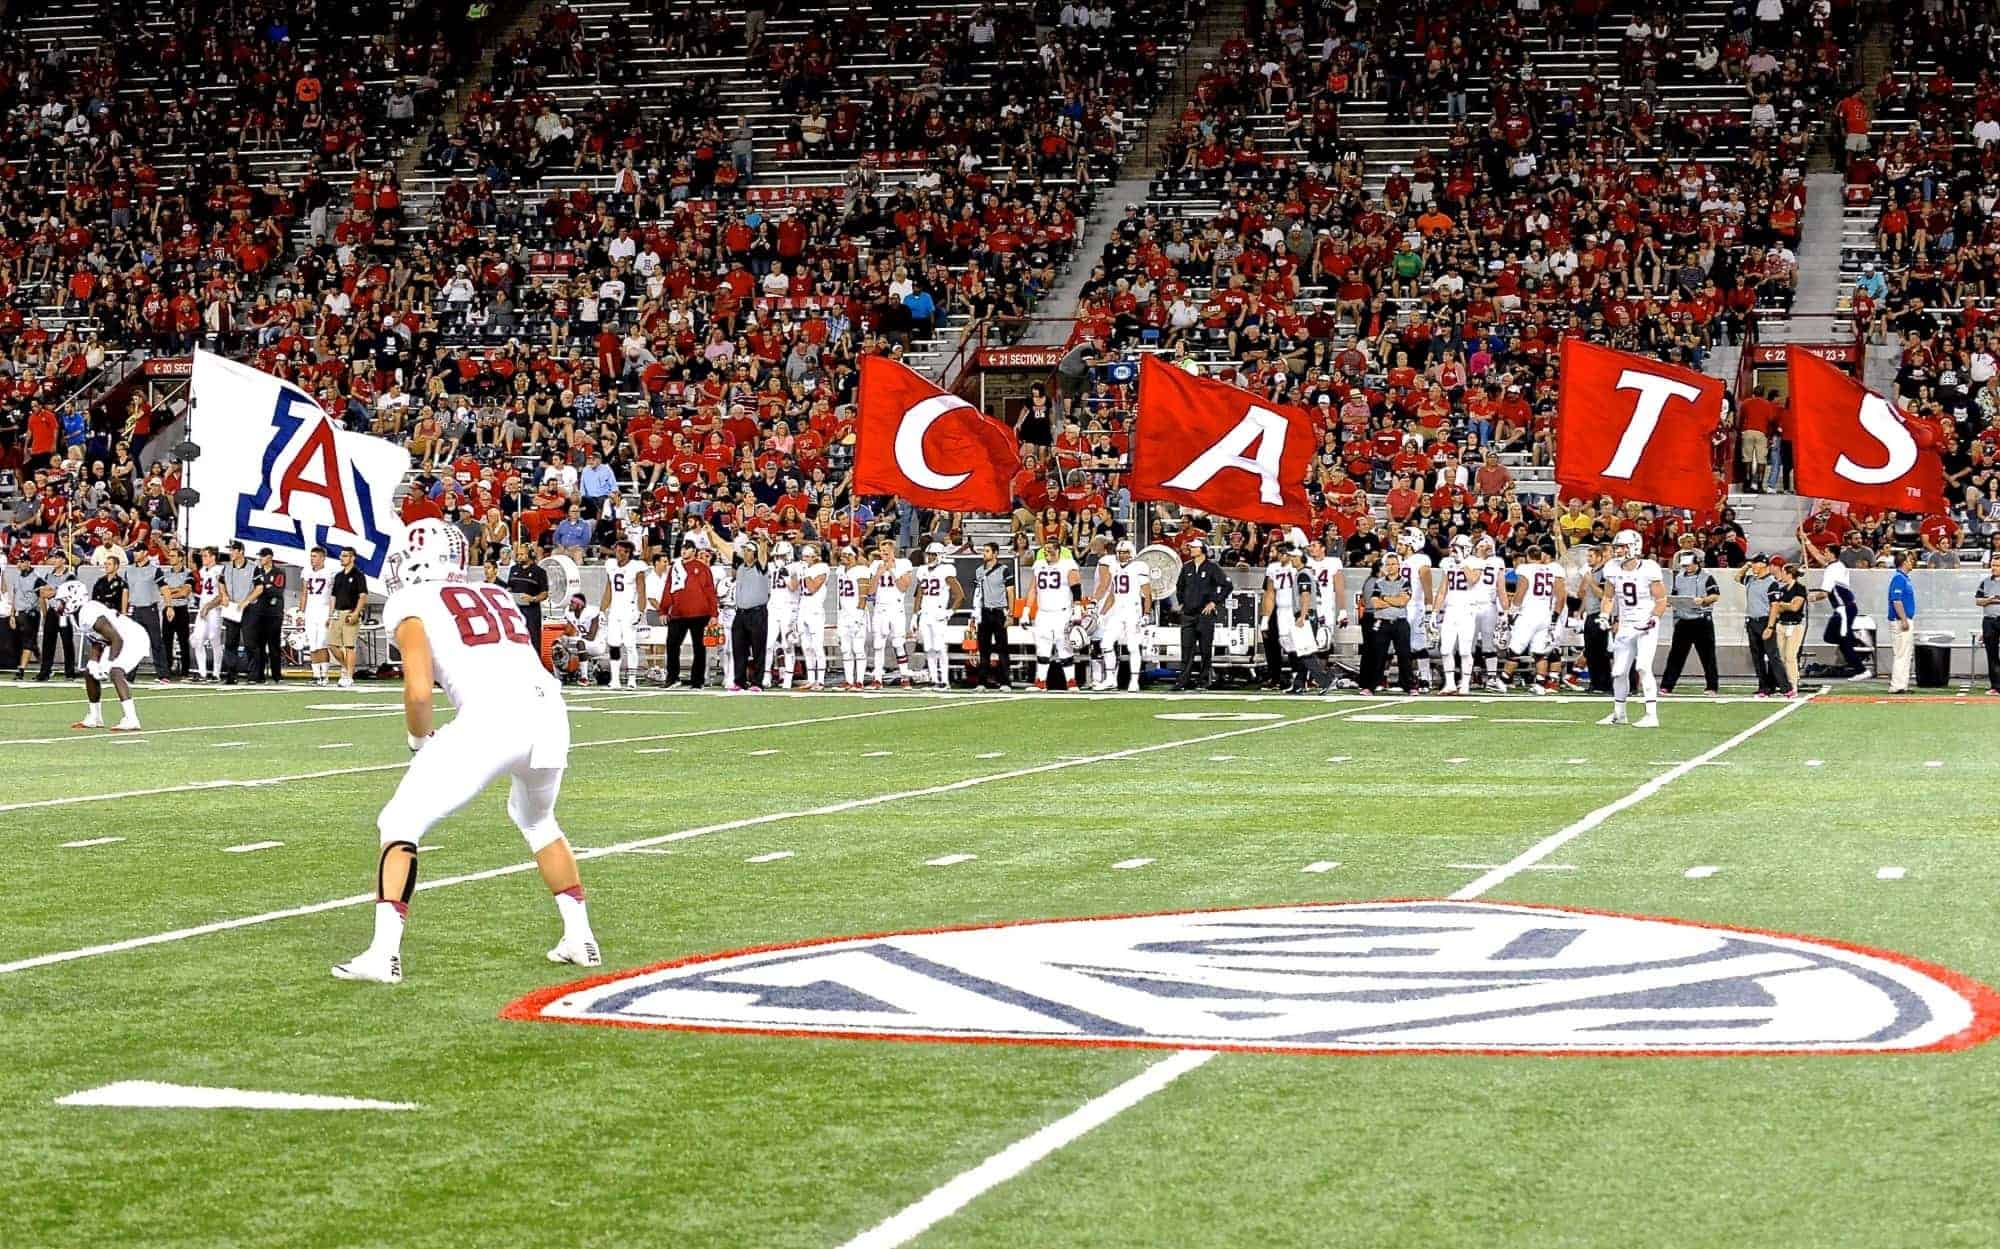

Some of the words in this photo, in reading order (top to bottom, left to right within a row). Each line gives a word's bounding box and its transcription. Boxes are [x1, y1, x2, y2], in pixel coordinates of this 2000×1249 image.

[999, 353, 1008, 365] 21
[1010, 353, 1044, 365] SECTION
[1046, 353, 1057, 365] 22
[1775, 349, 1785, 361] 22
[1825, 349, 1836, 361] 23
[1600, 370, 1701, 479] T
[893, 394, 973, 490] C
[1834, 391, 1918, 485] S
[1161, 405, 1289, 506] A
[613, 573, 625, 592] 6
[879, 575, 895, 588] 11
[1037, 571, 1061, 590] 63
[1113, 574, 1130, 594] 19
[1275, 572, 1294, 590] 71
[1532, 572, 1553, 596] 65
[1623, 582, 1637, 606] 9
